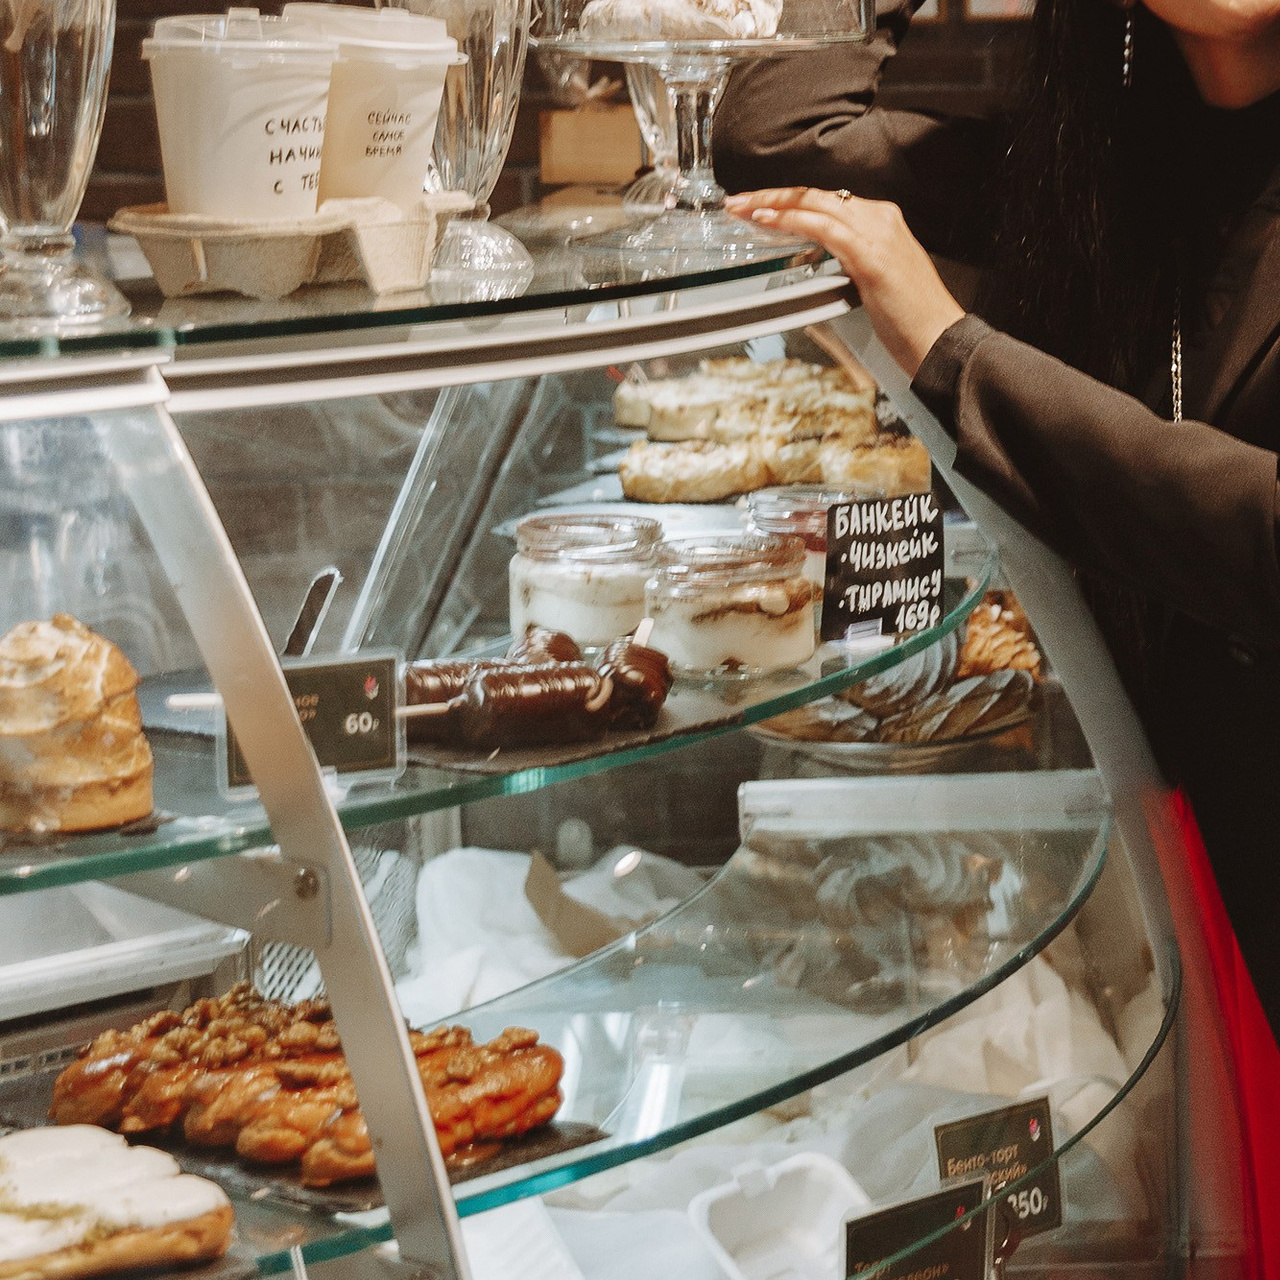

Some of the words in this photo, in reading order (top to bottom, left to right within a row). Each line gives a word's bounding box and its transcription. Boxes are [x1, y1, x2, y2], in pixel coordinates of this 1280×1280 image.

[265, 117, 325, 135] СЧАСТЬ
[835, 494, 939, 539] БАНКЕЙК
[845, 568, 942, 613] ТИРАМИСУ
